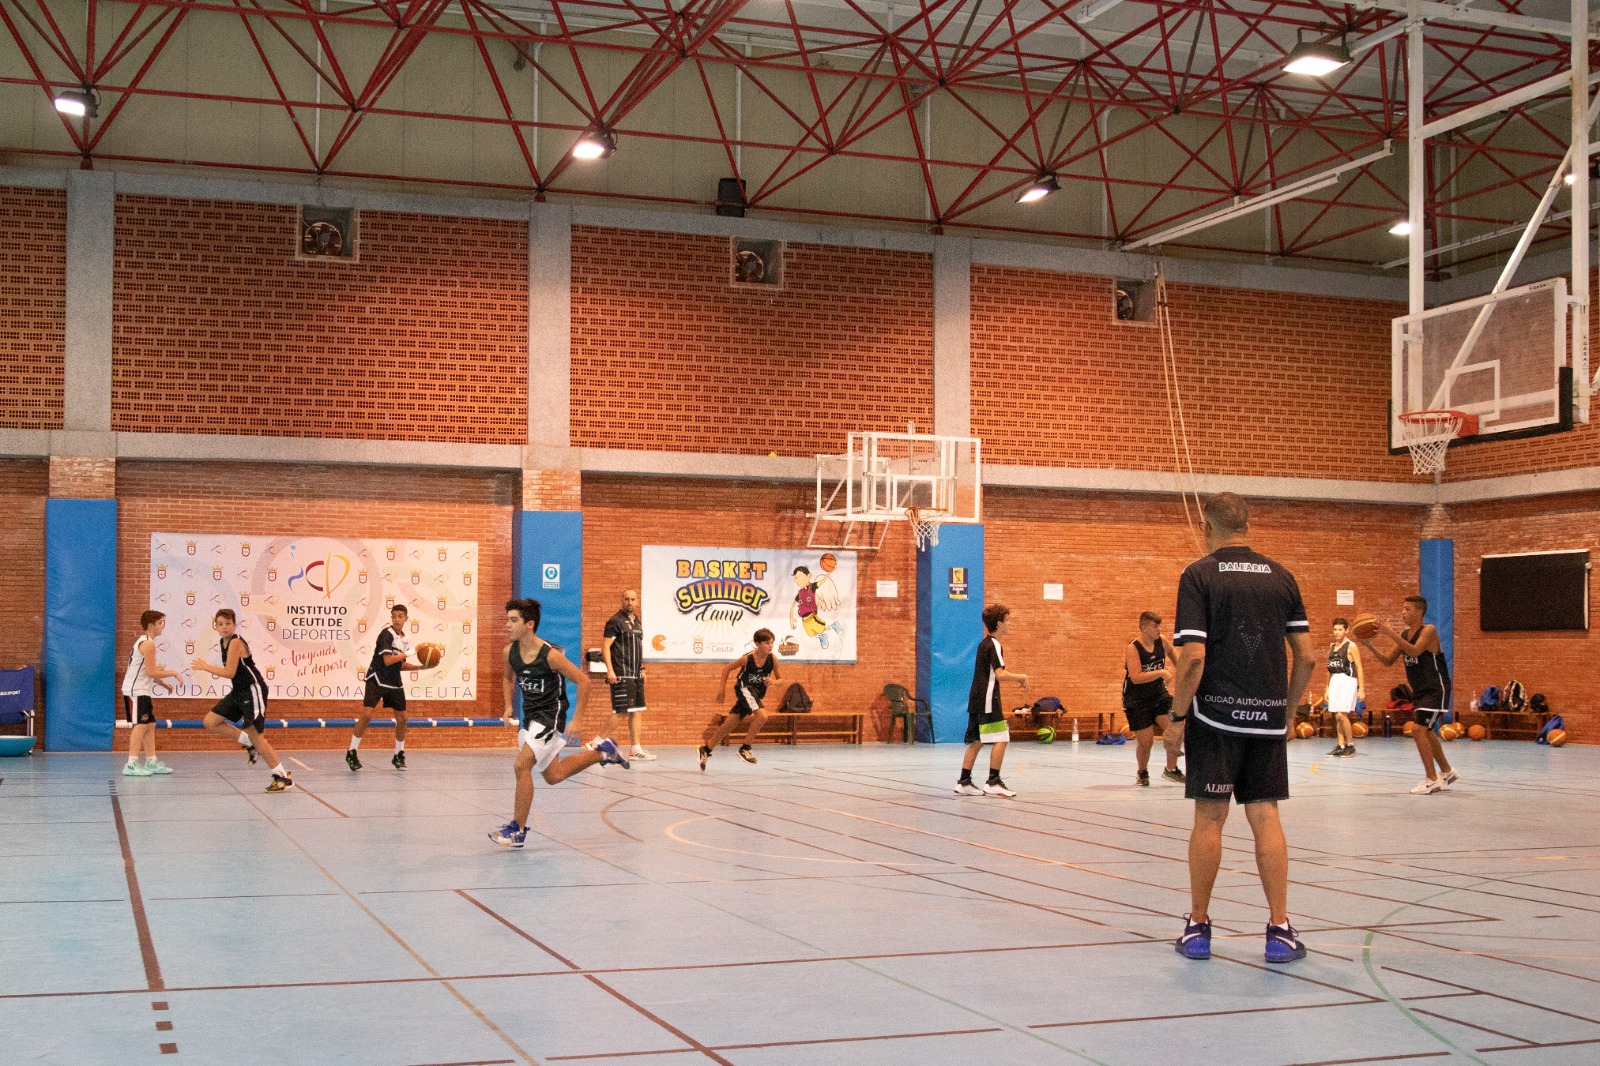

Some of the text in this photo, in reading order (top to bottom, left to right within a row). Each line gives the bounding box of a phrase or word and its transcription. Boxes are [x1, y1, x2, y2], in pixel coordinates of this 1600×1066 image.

[676, 560, 767, 580] BASKET
[287, 605, 347, 615] INSTITUTO
[291, 617, 343, 627] CEUTI DE
[282, 628, 351, 640] DEPORTES
[711, 644, 734, 654] Ceuta
[281, 645, 337, 667] Apoyando
[297, 659, 348, 677] al deporte
[266, 683, 364, 698] TÓNOMA
[410, 686, 473, 698] CEUTA
[1204, 694, 1235, 704] CIUDAD
[1231, 710, 1268, 721] CEUTA
